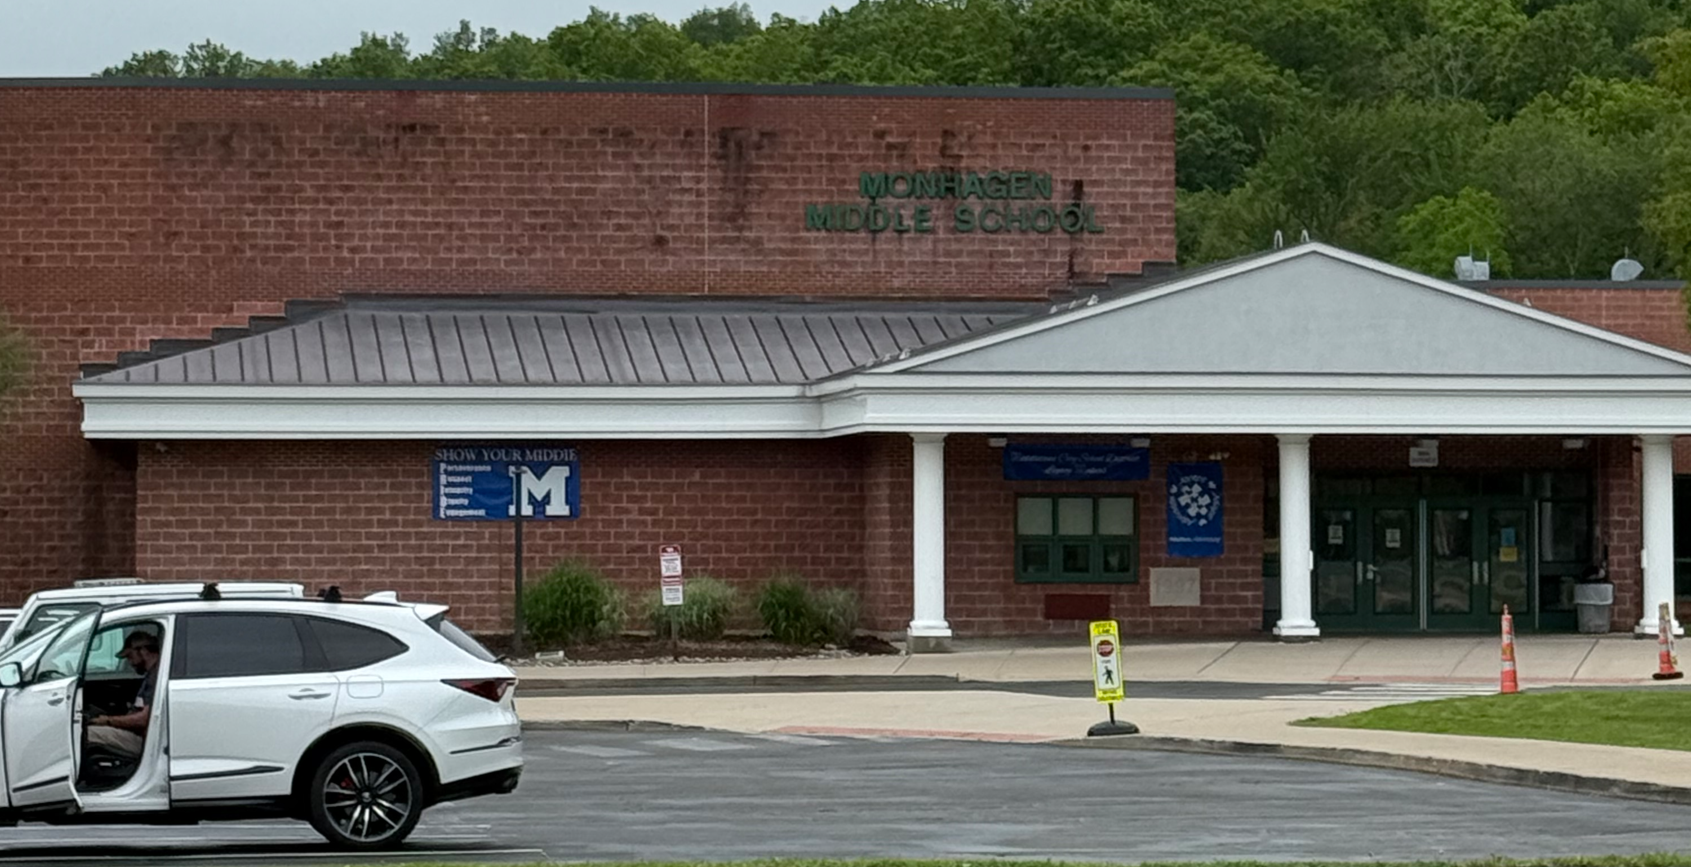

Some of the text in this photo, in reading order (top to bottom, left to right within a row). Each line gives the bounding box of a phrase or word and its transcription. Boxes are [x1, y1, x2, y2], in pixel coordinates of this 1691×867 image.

[860, 171, 1053, 200] MONHAGEN
[805, 203, 1105, 233] MIDDLE SCHOOL
[434, 449, 579, 461] SHOW YOUR MIDDIE
